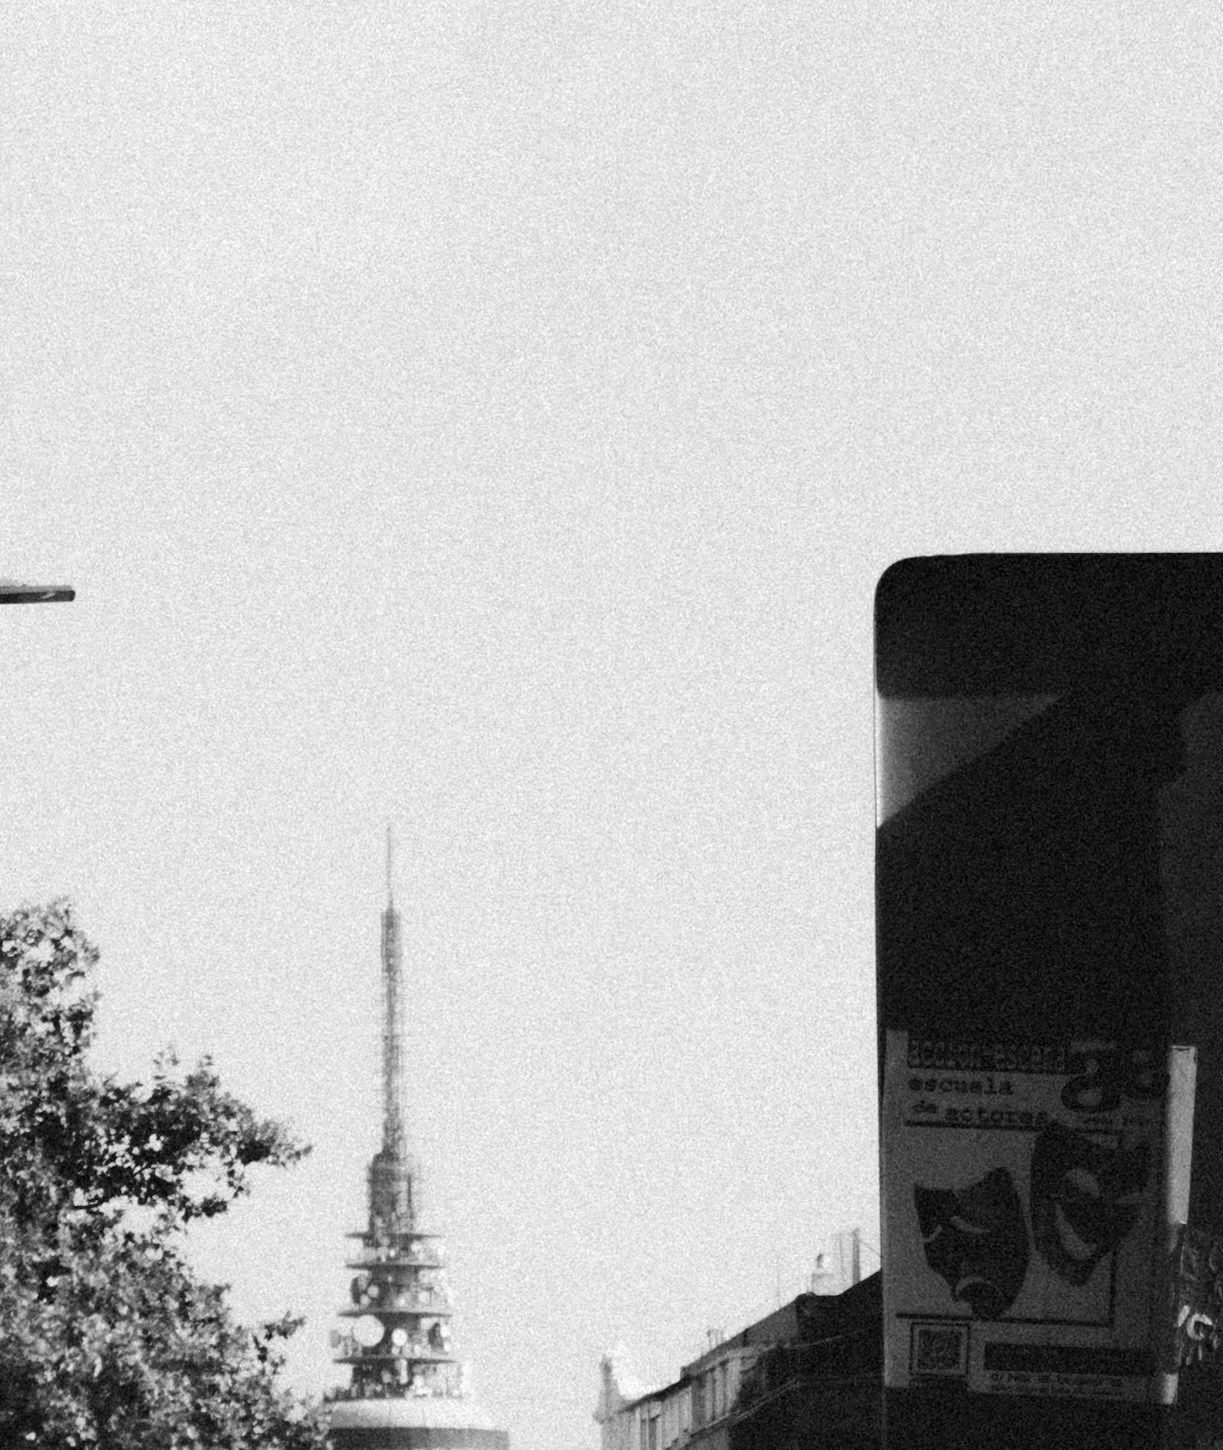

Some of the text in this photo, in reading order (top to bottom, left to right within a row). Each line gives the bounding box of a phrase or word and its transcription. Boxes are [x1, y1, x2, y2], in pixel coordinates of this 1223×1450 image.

[908, 1076, 1014, 1096] escuela
[912, 1099, 1049, 1126] de actores
